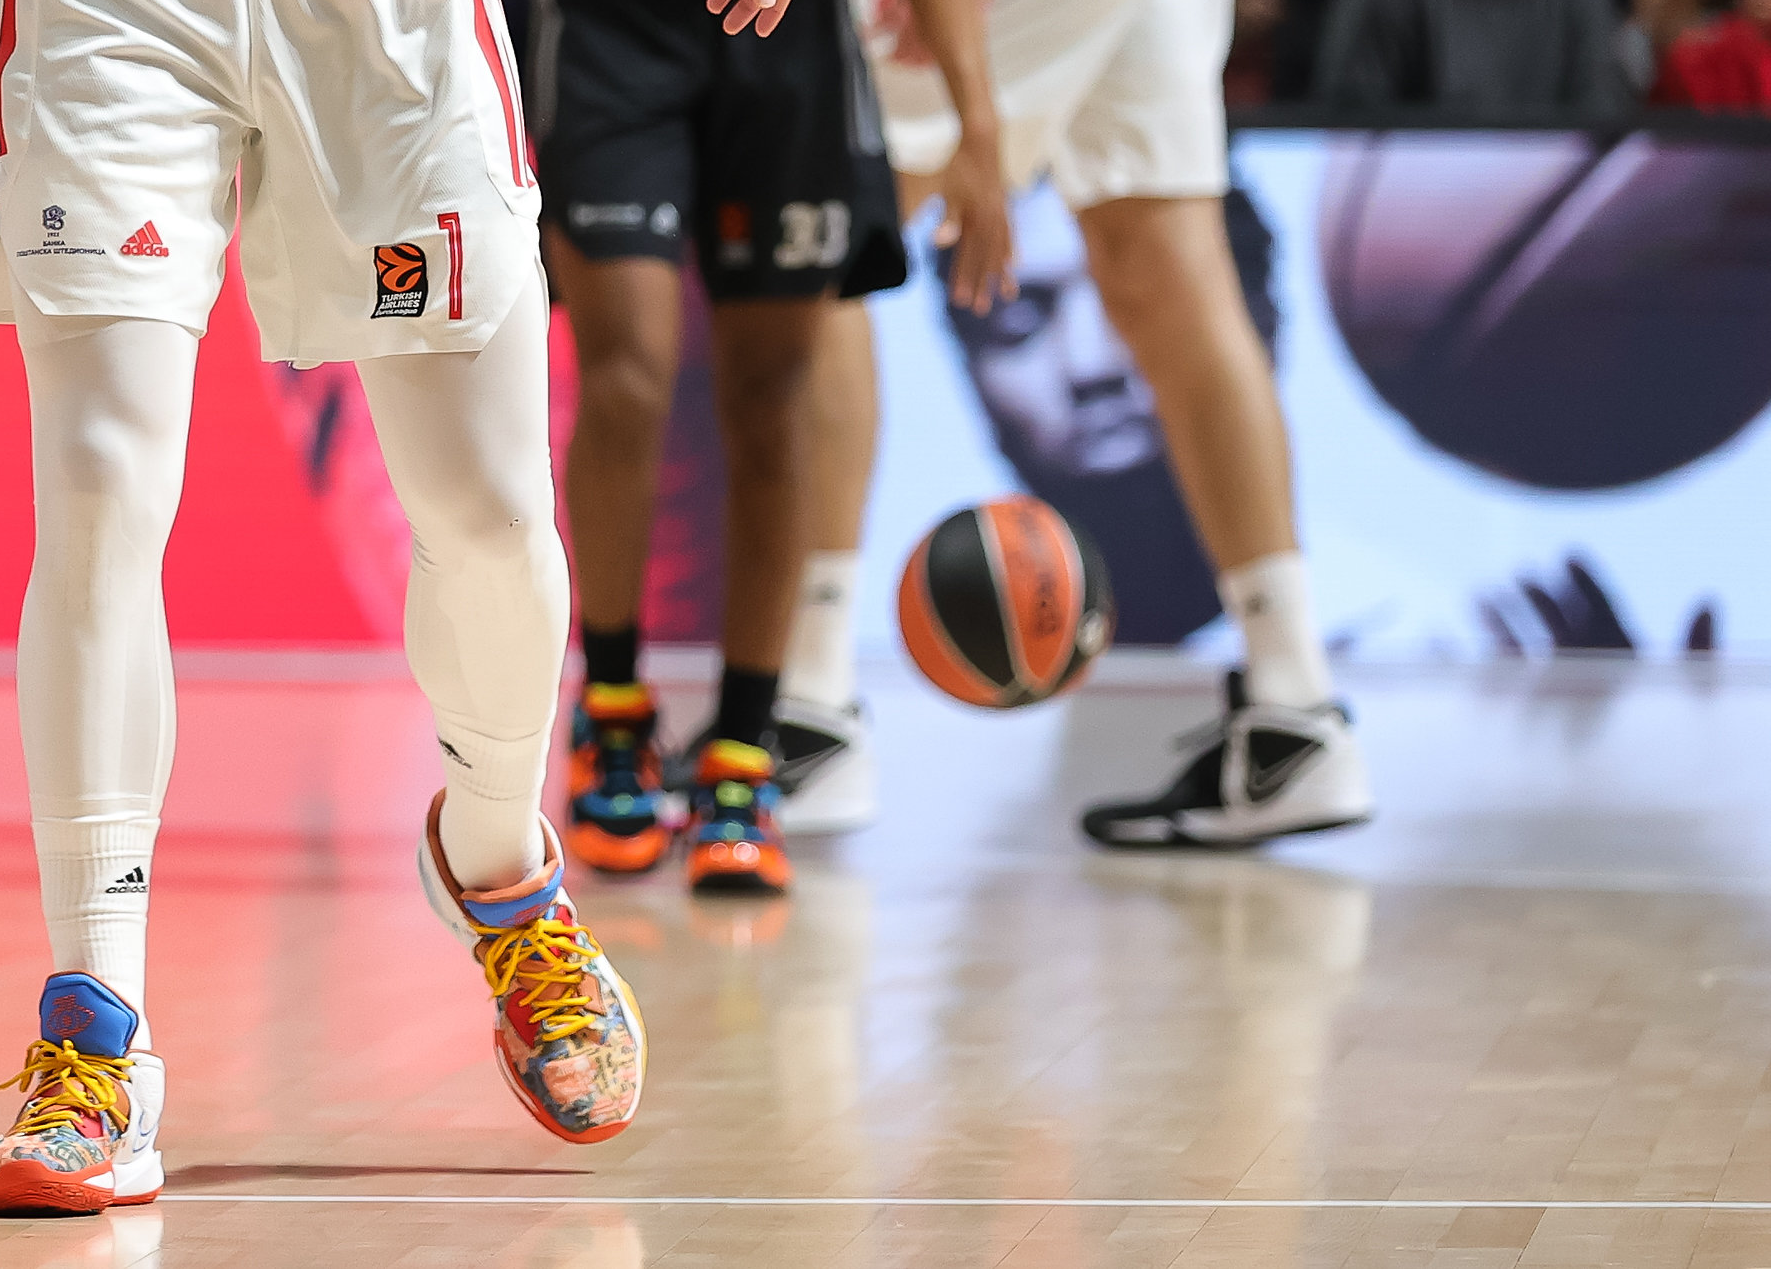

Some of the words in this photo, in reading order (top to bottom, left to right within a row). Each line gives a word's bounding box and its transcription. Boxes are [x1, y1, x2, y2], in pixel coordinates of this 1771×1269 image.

[120, 243, 170, 258] adidas
[437, 211, 463, 320] 1
[381, 291, 423, 303] TURKISH
[378, 299, 421, 310] AIRLINES
